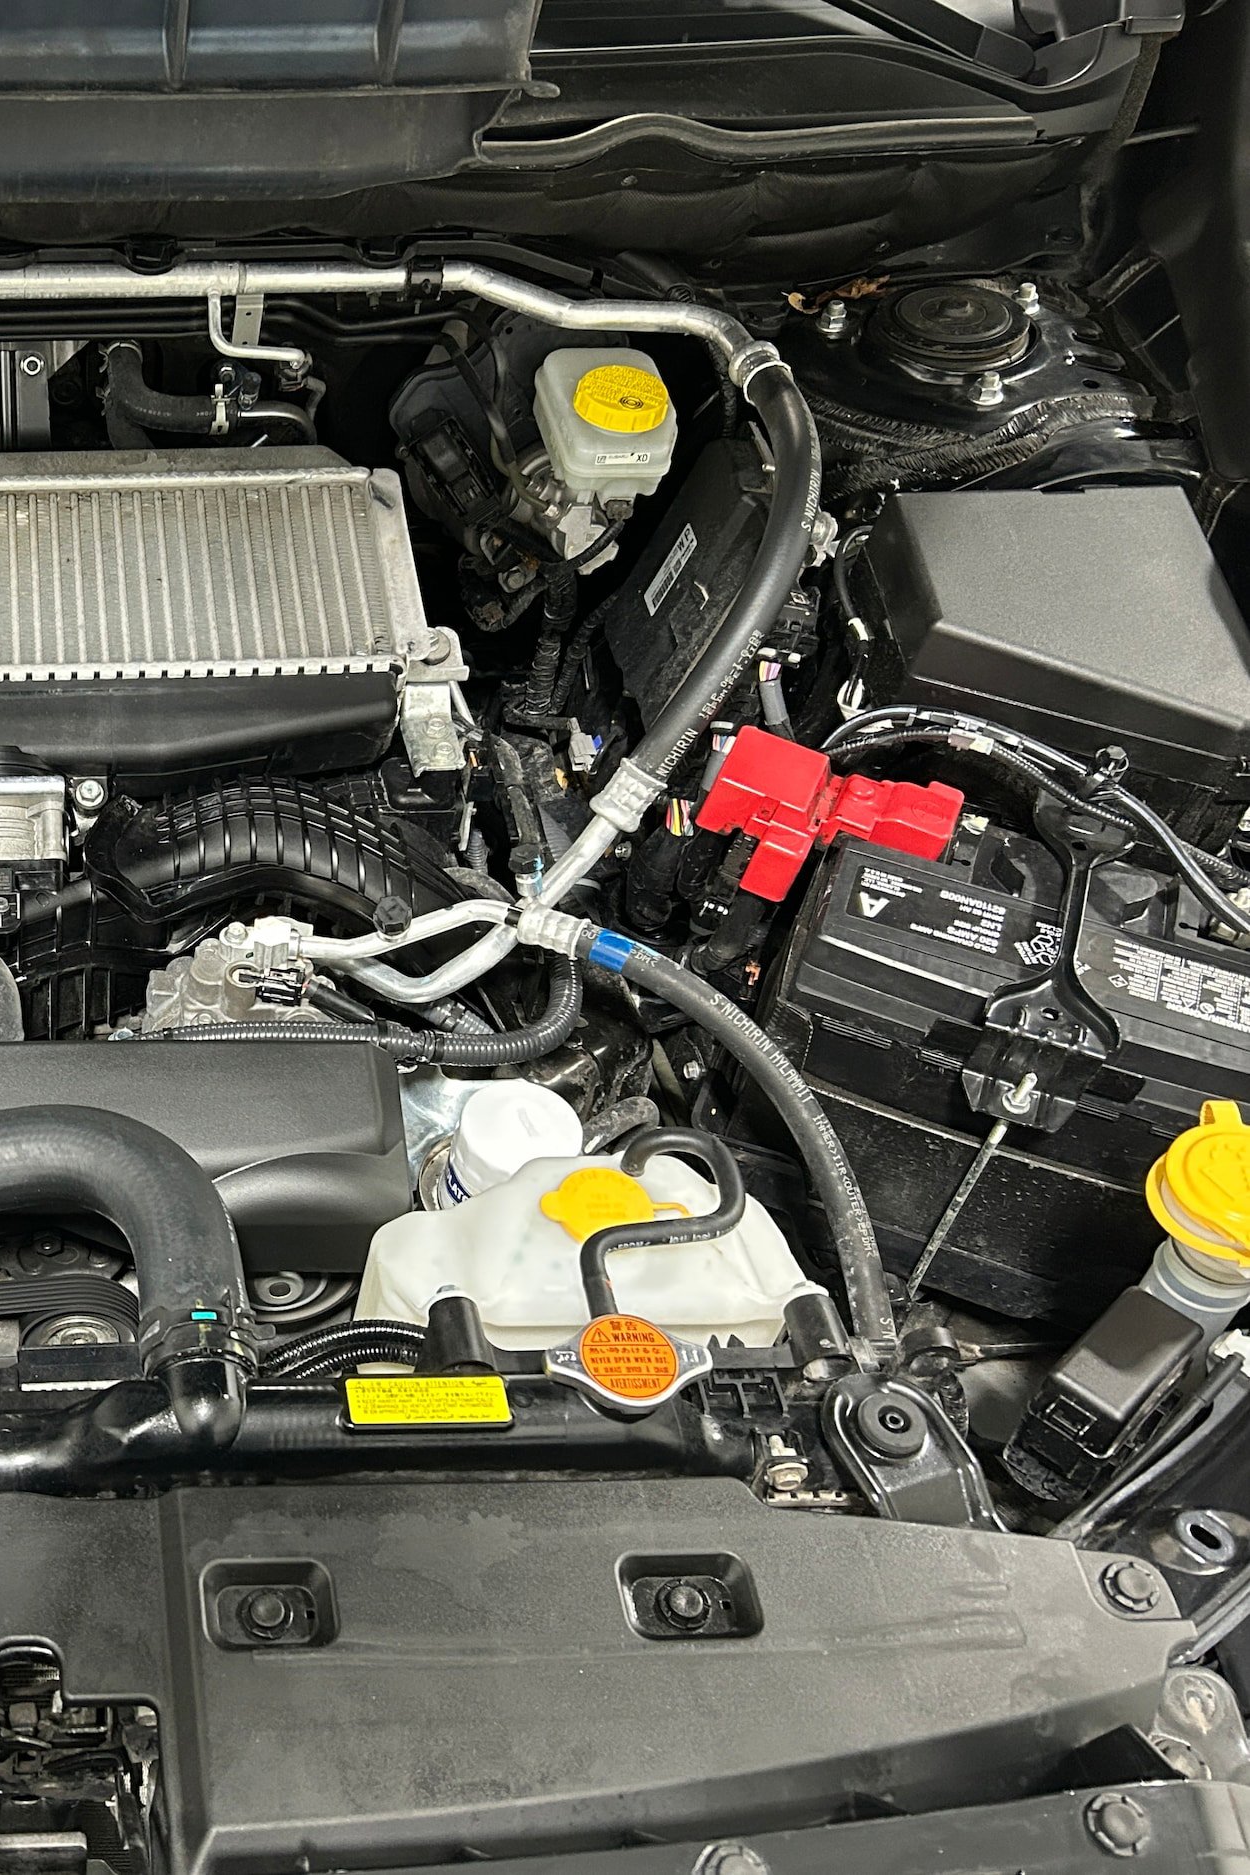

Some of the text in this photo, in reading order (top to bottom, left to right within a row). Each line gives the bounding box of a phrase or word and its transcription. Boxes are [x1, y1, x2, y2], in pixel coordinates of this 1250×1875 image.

[859, 891, 890, 918] A
[946, 926, 979, 941] AMPS
[710, 993, 774, 1052] S-NICHIRIN
[611, 1332, 655, 1343] WARNING
[614, 1356, 631, 1364] OPEN
